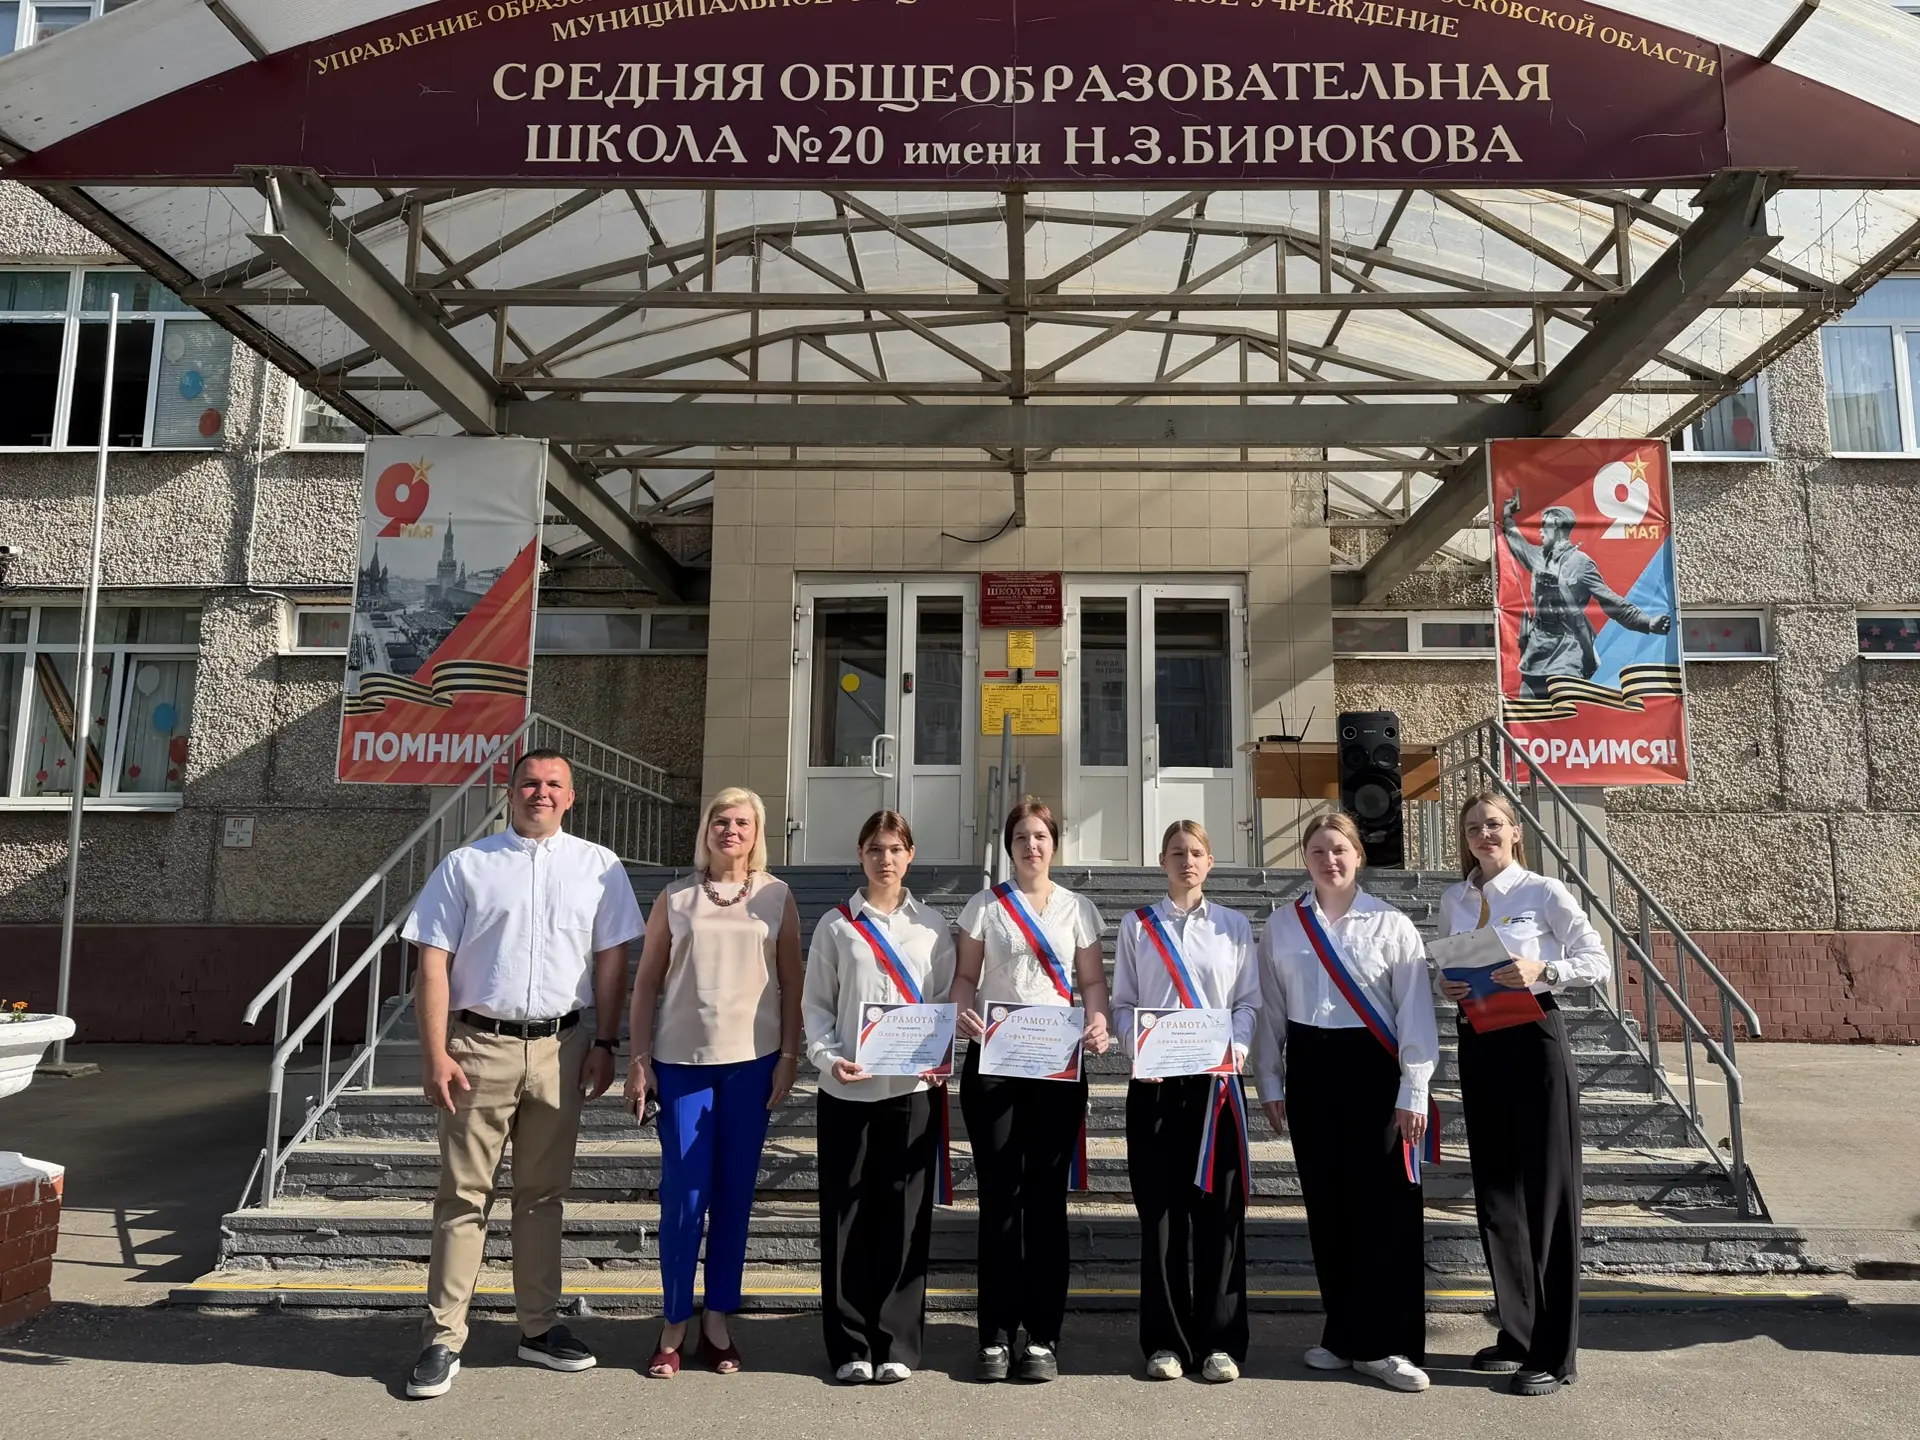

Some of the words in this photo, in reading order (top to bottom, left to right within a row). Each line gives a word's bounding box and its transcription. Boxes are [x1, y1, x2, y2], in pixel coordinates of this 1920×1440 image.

[314, 10, 482, 75] УПРАВЛЕНИЕ
[1600, 26, 1718, 76] ОБЛАСТИ
[492, 62, 765, 109] СРЕДНЯЯ
[779, 62, 1552, 112] ОБЩЕОБРАЗОВАТЕЛЬНАЯ
[525, 124, 748, 163] ШКОЛА
[767, 124, 885, 165] №20
[903, 141, 1041, 165] имени
[1063, 124, 1523, 165] Н.З.БИРЮКОВА
[375, 462, 430, 538] 9
[1593, 461, 1650, 539] 9
[1624, 524, 1660, 540] МАЯ
[400, 524, 434, 538] МАЯ
[886, 1016, 934, 1024] ГРАМОТА
[1011, 1016, 1059, 1026] ГРАМОТА
